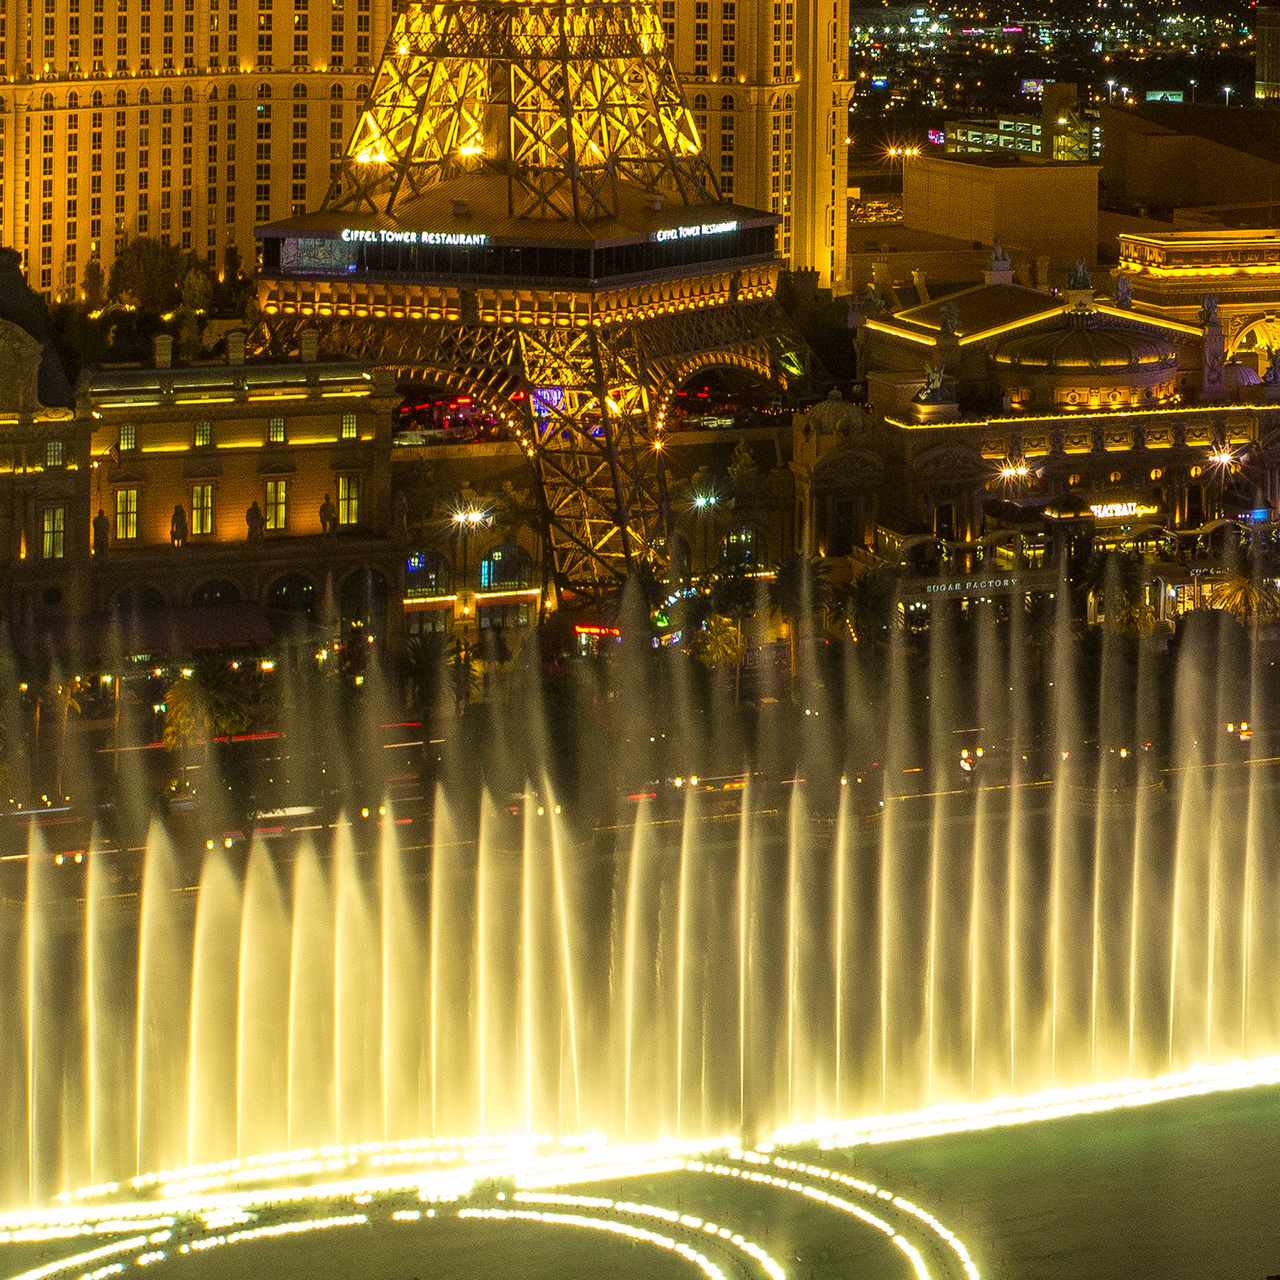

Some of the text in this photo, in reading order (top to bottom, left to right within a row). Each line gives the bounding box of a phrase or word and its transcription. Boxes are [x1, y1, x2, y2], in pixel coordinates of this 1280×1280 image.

[341, 228, 487, 245] EIFFEL TOWER RESTAURANT
[926, 578, 1018, 593] SUGAR FACTORY
